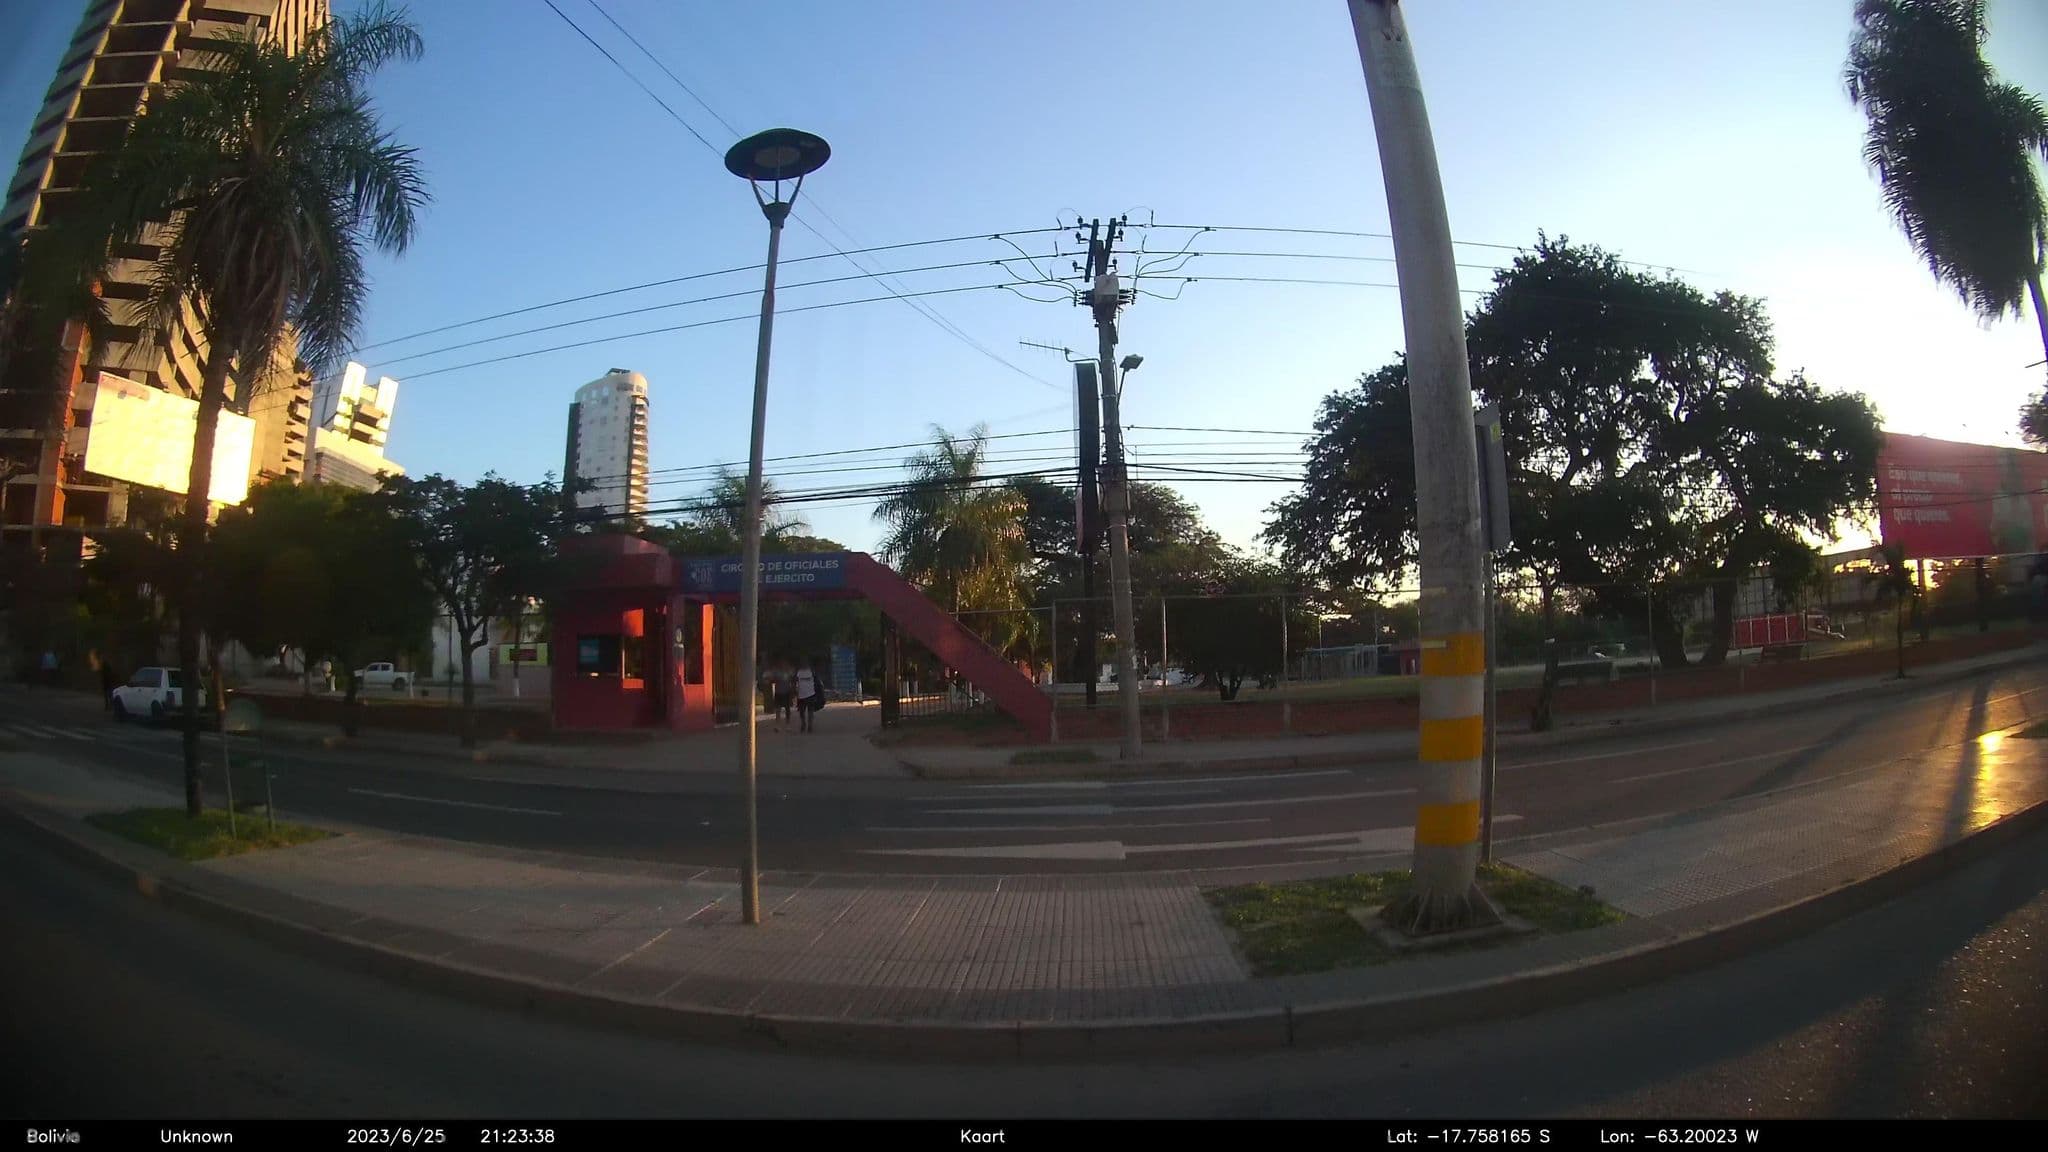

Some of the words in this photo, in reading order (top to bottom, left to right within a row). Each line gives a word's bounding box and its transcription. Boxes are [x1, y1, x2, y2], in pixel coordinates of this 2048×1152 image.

[721, 563, 765, 574] CIRCO
[768, 561, 782, 571] DE
[784, 560, 839, 570] OFICIALES
[765, 573, 815, 584] EJERCITO
